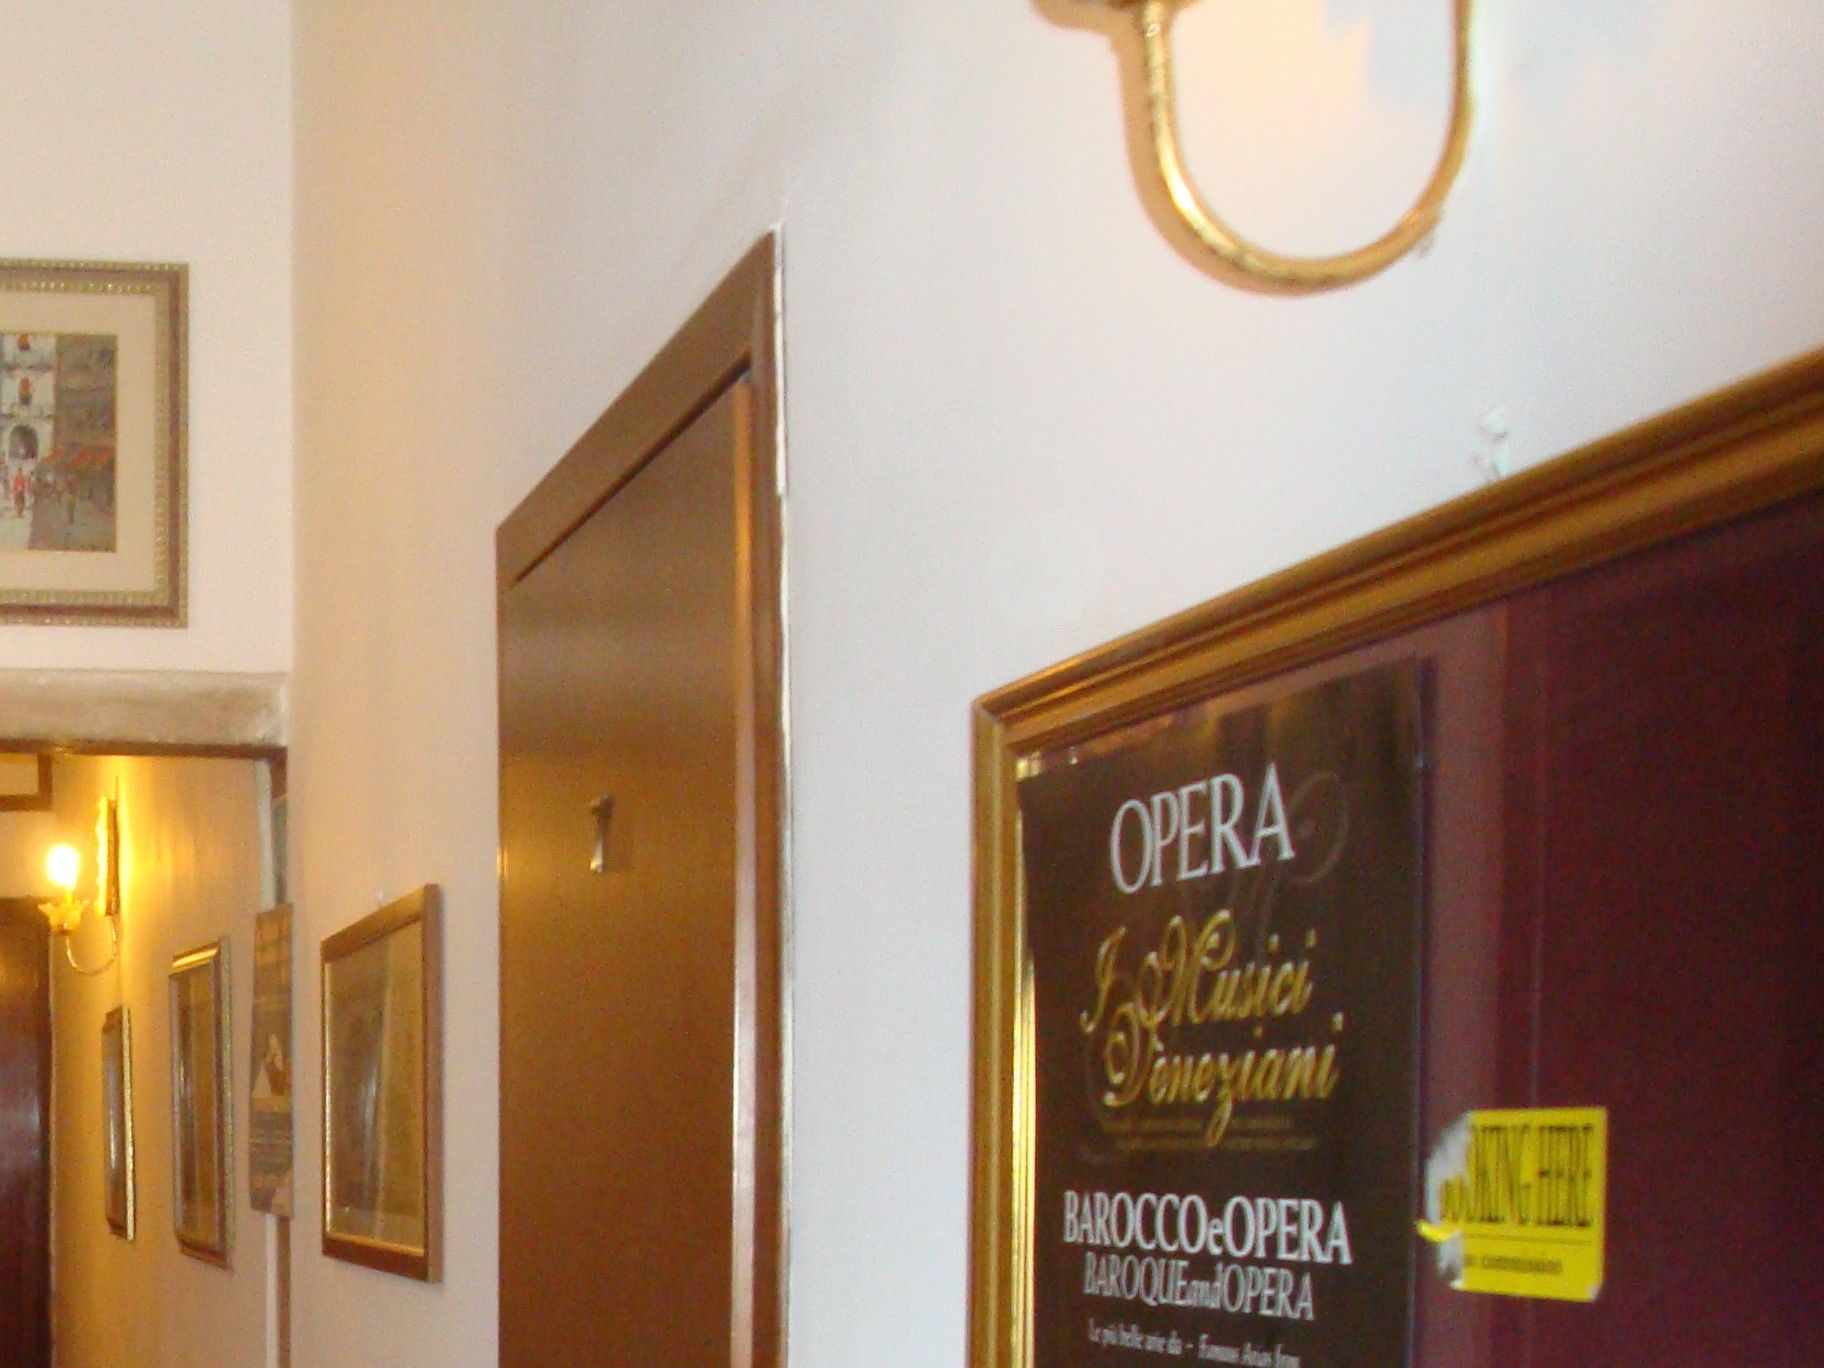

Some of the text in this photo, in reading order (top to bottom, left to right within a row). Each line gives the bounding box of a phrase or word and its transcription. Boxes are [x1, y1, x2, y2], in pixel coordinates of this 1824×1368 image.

[1110, 762, 1294, 894] OPERA
[1136, 909, 1316, 1026] Musici
[1103, 1003, 1343, 1147] Veneziani
